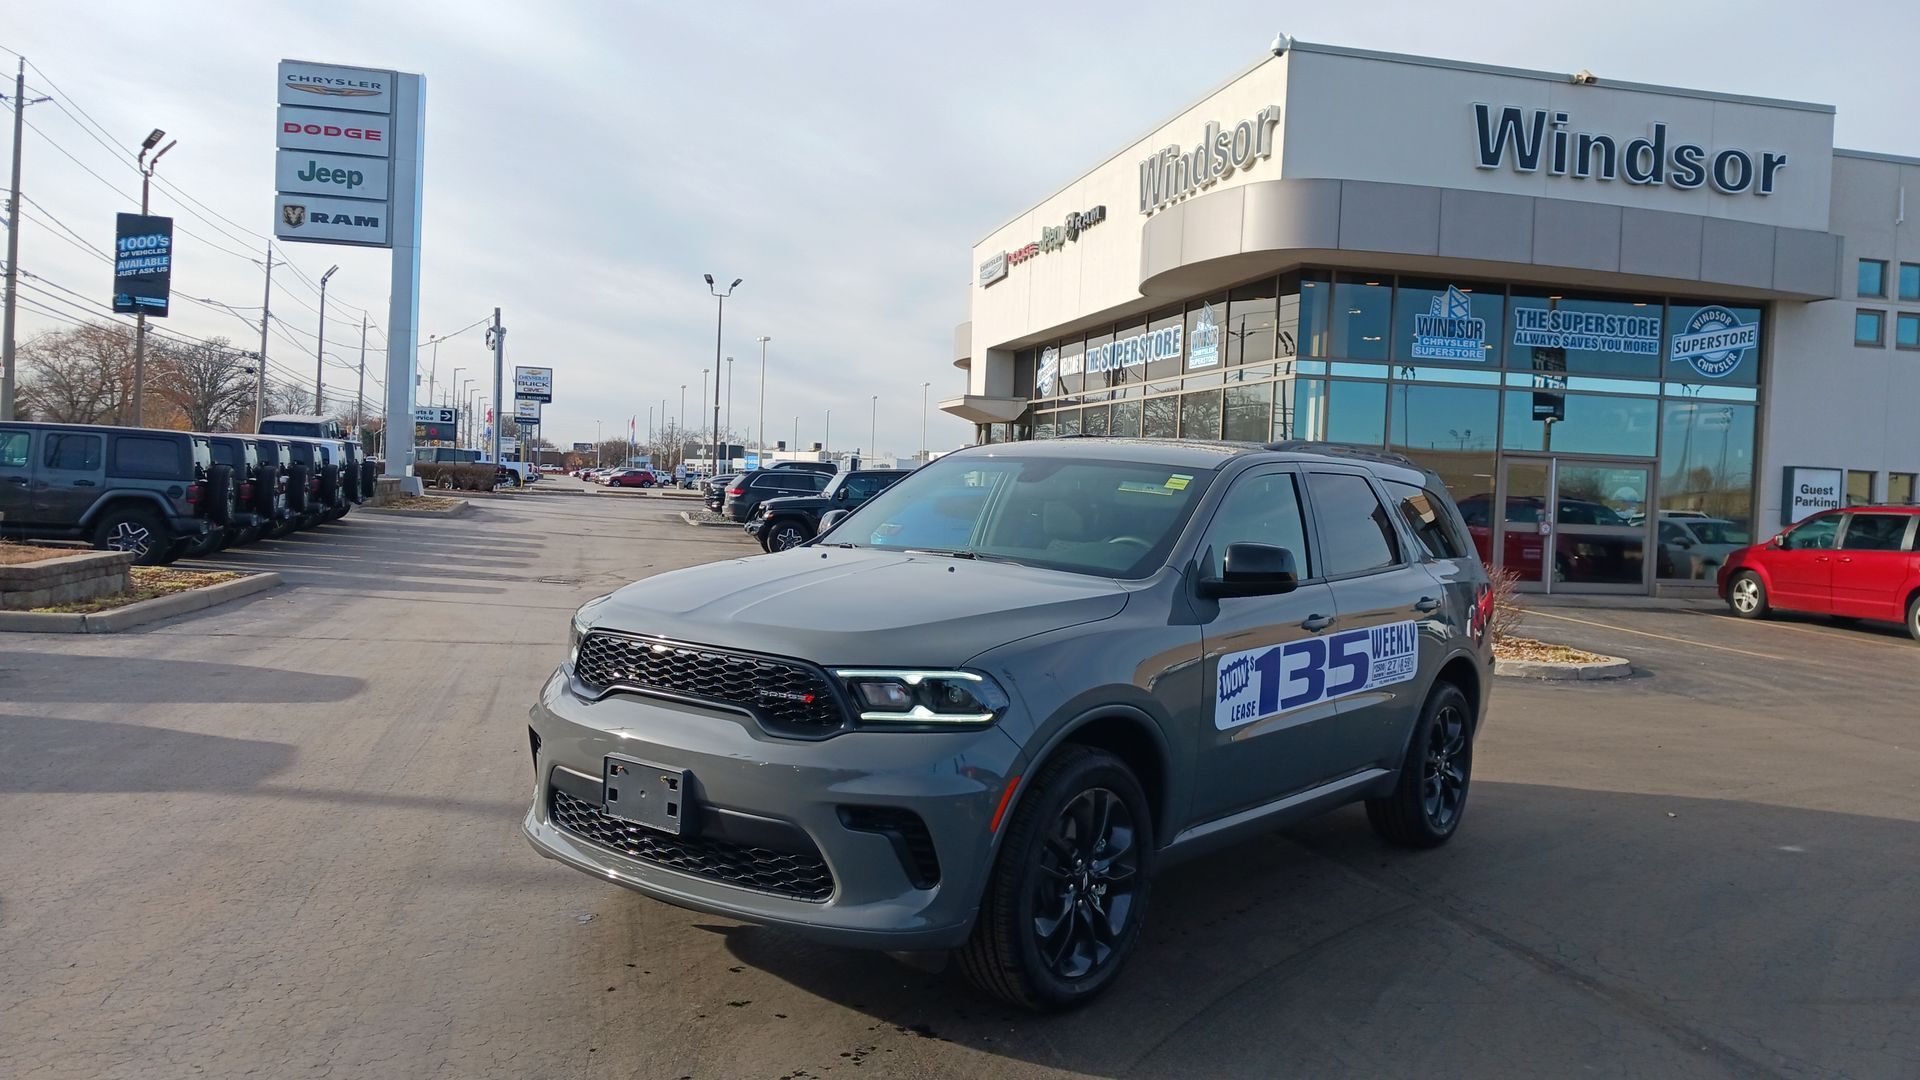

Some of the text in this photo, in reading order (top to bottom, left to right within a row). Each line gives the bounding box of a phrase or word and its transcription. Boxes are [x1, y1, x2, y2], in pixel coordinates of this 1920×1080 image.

[287, 75, 382, 89] CHRYSLER
[284, 122, 382, 141] DODGE
[1139, 104, 1280, 215] Windsor
[1472, 102, 1787, 196] Windsor
[297, 160, 364, 189] Jeep
[310, 212, 379, 227] RAM
[1074, 205, 1105, 229] RAM
[118, 256, 169, 269] AVAILABLE
[131, 248, 167, 256] VEHICLES
[117, 269, 137, 277] JUST
[139, 267, 155, 275] ASK
[1417, 316, 1483, 340] WINDSOR
[1516, 309, 1659, 338] THE SUPERSTORE
[1692, 311, 1732, 330] WINDSOR
[1087, 349, 1099, 372] THE
[1102, 327, 1182, 371] SUPERSTORE
[1422, 337, 1476, 348] CHRYSLER
[1515, 332, 1658, 353] ALWAYS SAVES YOU MORE!
[1675, 329, 1755, 354] SUPERSTORE
[1415, 347, 1483, 358] SUPERSTORE
[1697, 352, 1738, 373] CHRYSLER
[1800, 484, 1833, 495] Guest
[1795, 496, 1838, 509] Parking
[1371, 622, 1416, 660] WEEKLY
[1255, 630, 1370, 717] 135
[1387, 660, 1397, 671] 27
[1231, 701, 1256, 722] LEASE
